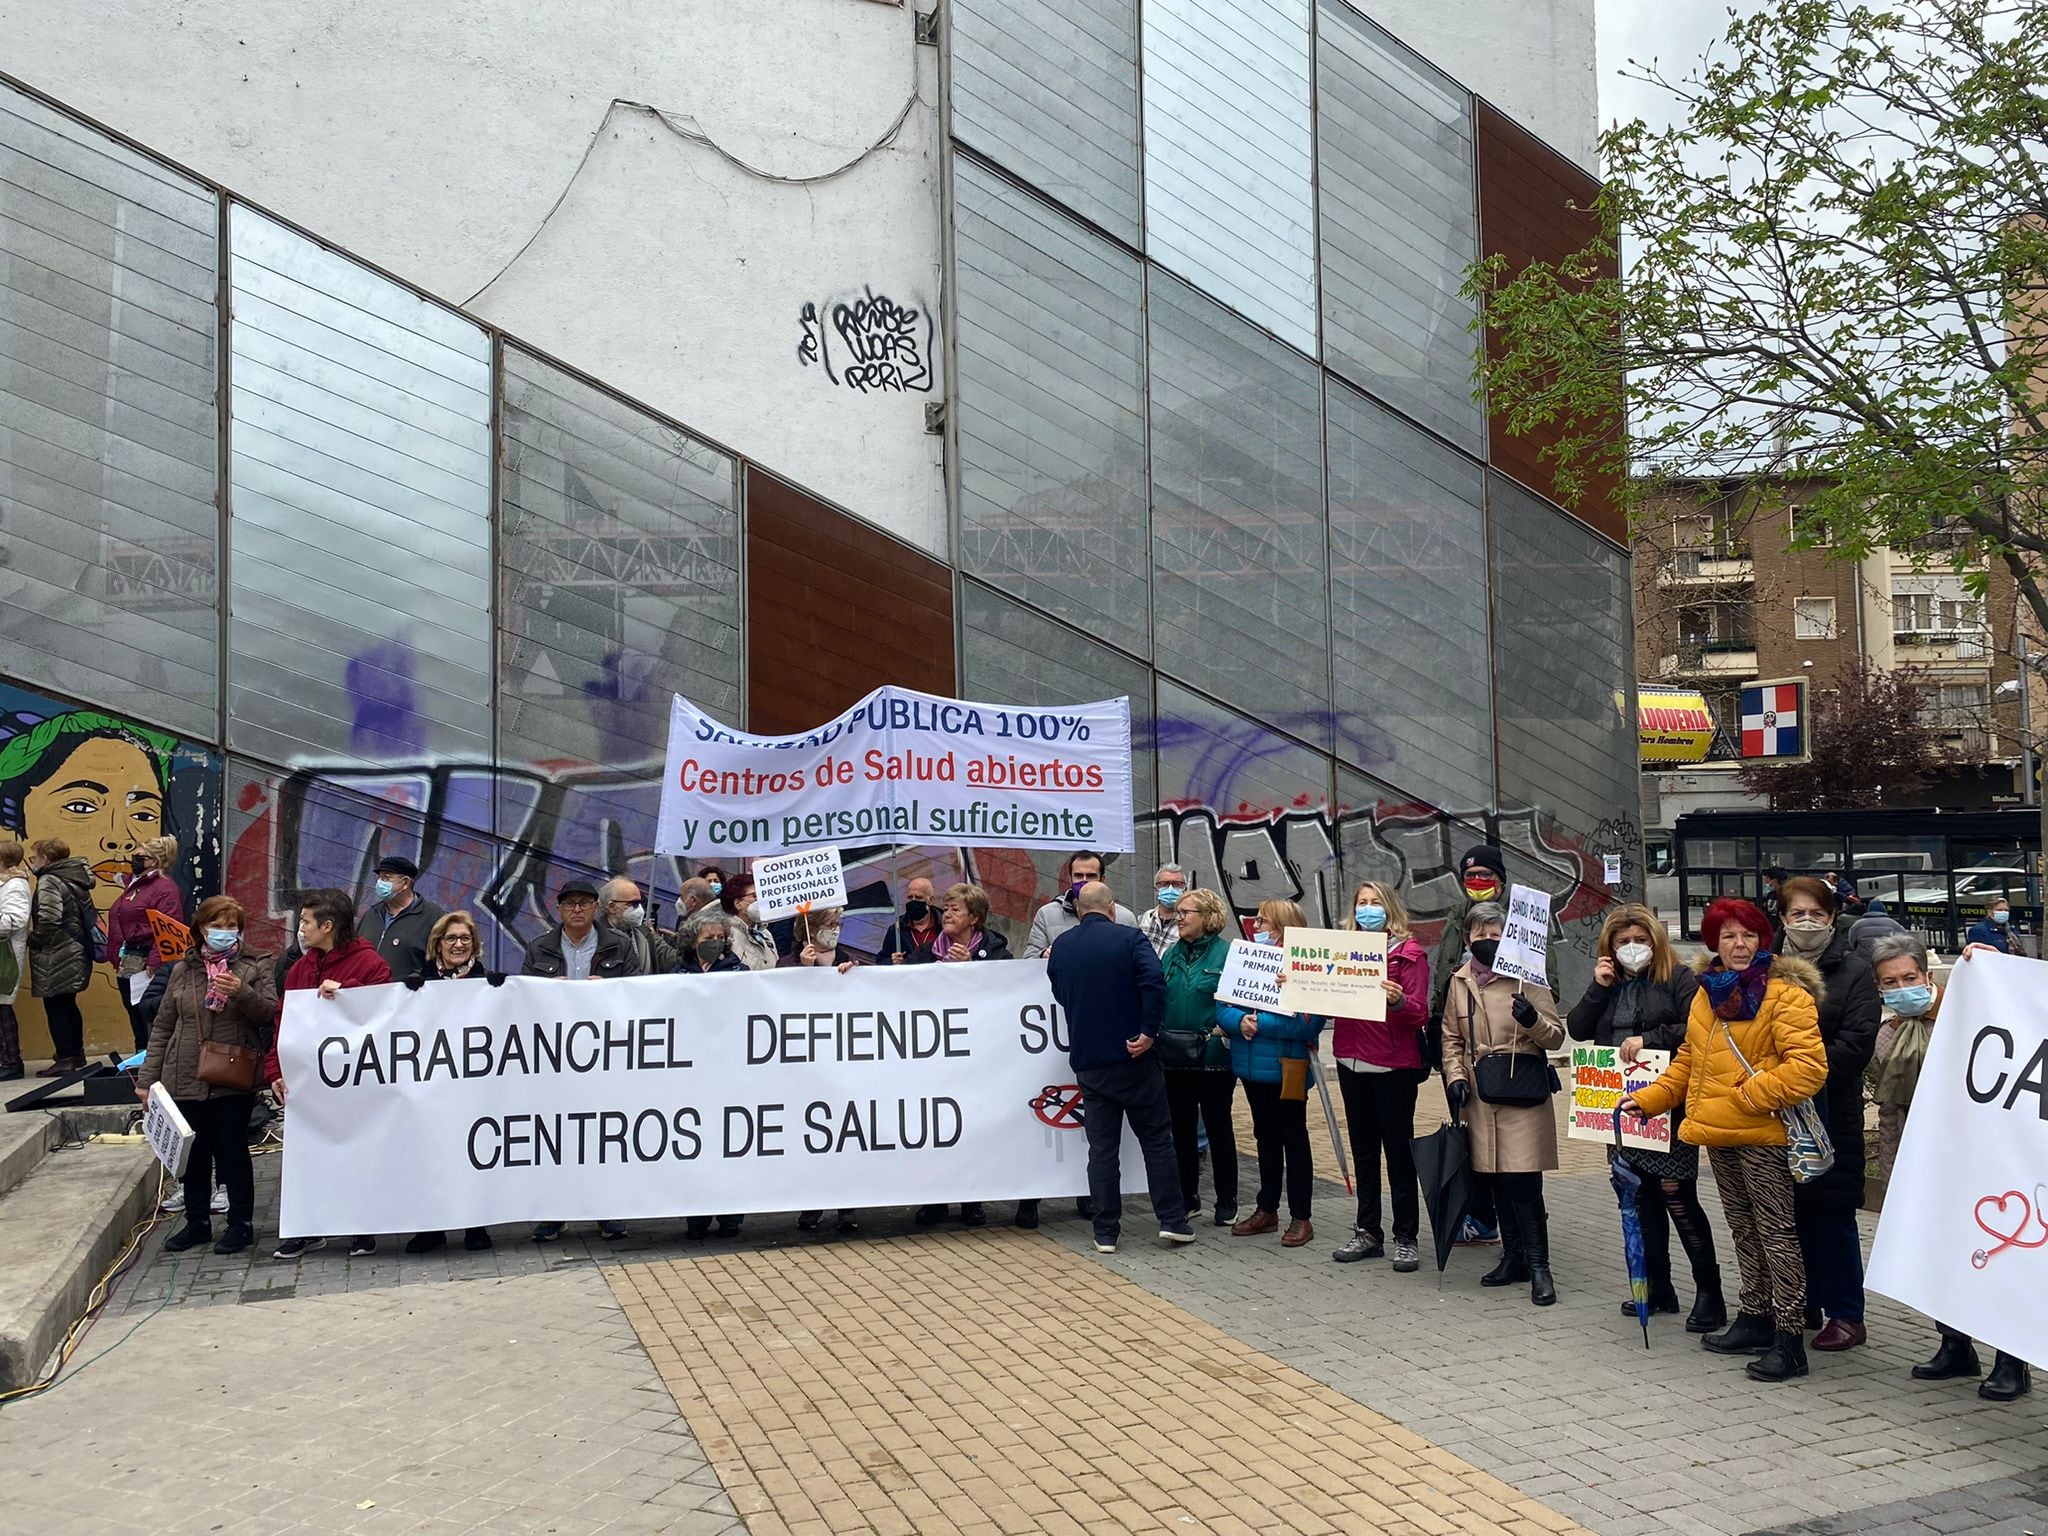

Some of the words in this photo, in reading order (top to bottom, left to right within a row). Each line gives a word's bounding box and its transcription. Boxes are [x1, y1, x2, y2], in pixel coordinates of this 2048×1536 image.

[996, 712, 1091, 741] 100%
[1657, 735, 1695, 745] Hombres
[680, 758, 805, 795] Centros
[815, 756, 854, 787] de
[864, 749, 955, 781] Salud
[966, 754, 1104, 787] abiertos
[683, 818, 699, 850] y
[709, 817, 769, 844] con
[782, 800, 918, 847] personal
[929, 801, 1094, 838] suficiente
[763, 852, 830, 873] CONTRATOS
[760, 871, 802, 887] DIGNOS
[805, 868, 813, 878] A
[816, 863, 837, 875] L@S
[761, 875, 839, 898] PROFESIONALES
[769, 899, 783, 909] DE
[786, 888, 835, 905] SANIDAD
[1506, 923, 1518, 939] DE
[1238, 946, 1249, 956] LA
[1251, 949, 1284, 962] ATENCI
[1237, 977, 1247, 987] ES
[1248, 980, 1259, 990] LA
[1232, 988, 1279, 1006] NECESARIA
[317, 1017, 693, 1088] CARABANCHEL
[747, 1008, 970, 1065] DEFIENDE
[1573, 1048, 1587, 1066] NO
[1588, 1049, 1596, 1066] A
[1596, 1048, 1616, 1068] LOS
[467, 1106, 702, 1170] CENTROS
[723, 1103, 785, 1158] DE
[803, 1096, 963, 1154] SALUD
